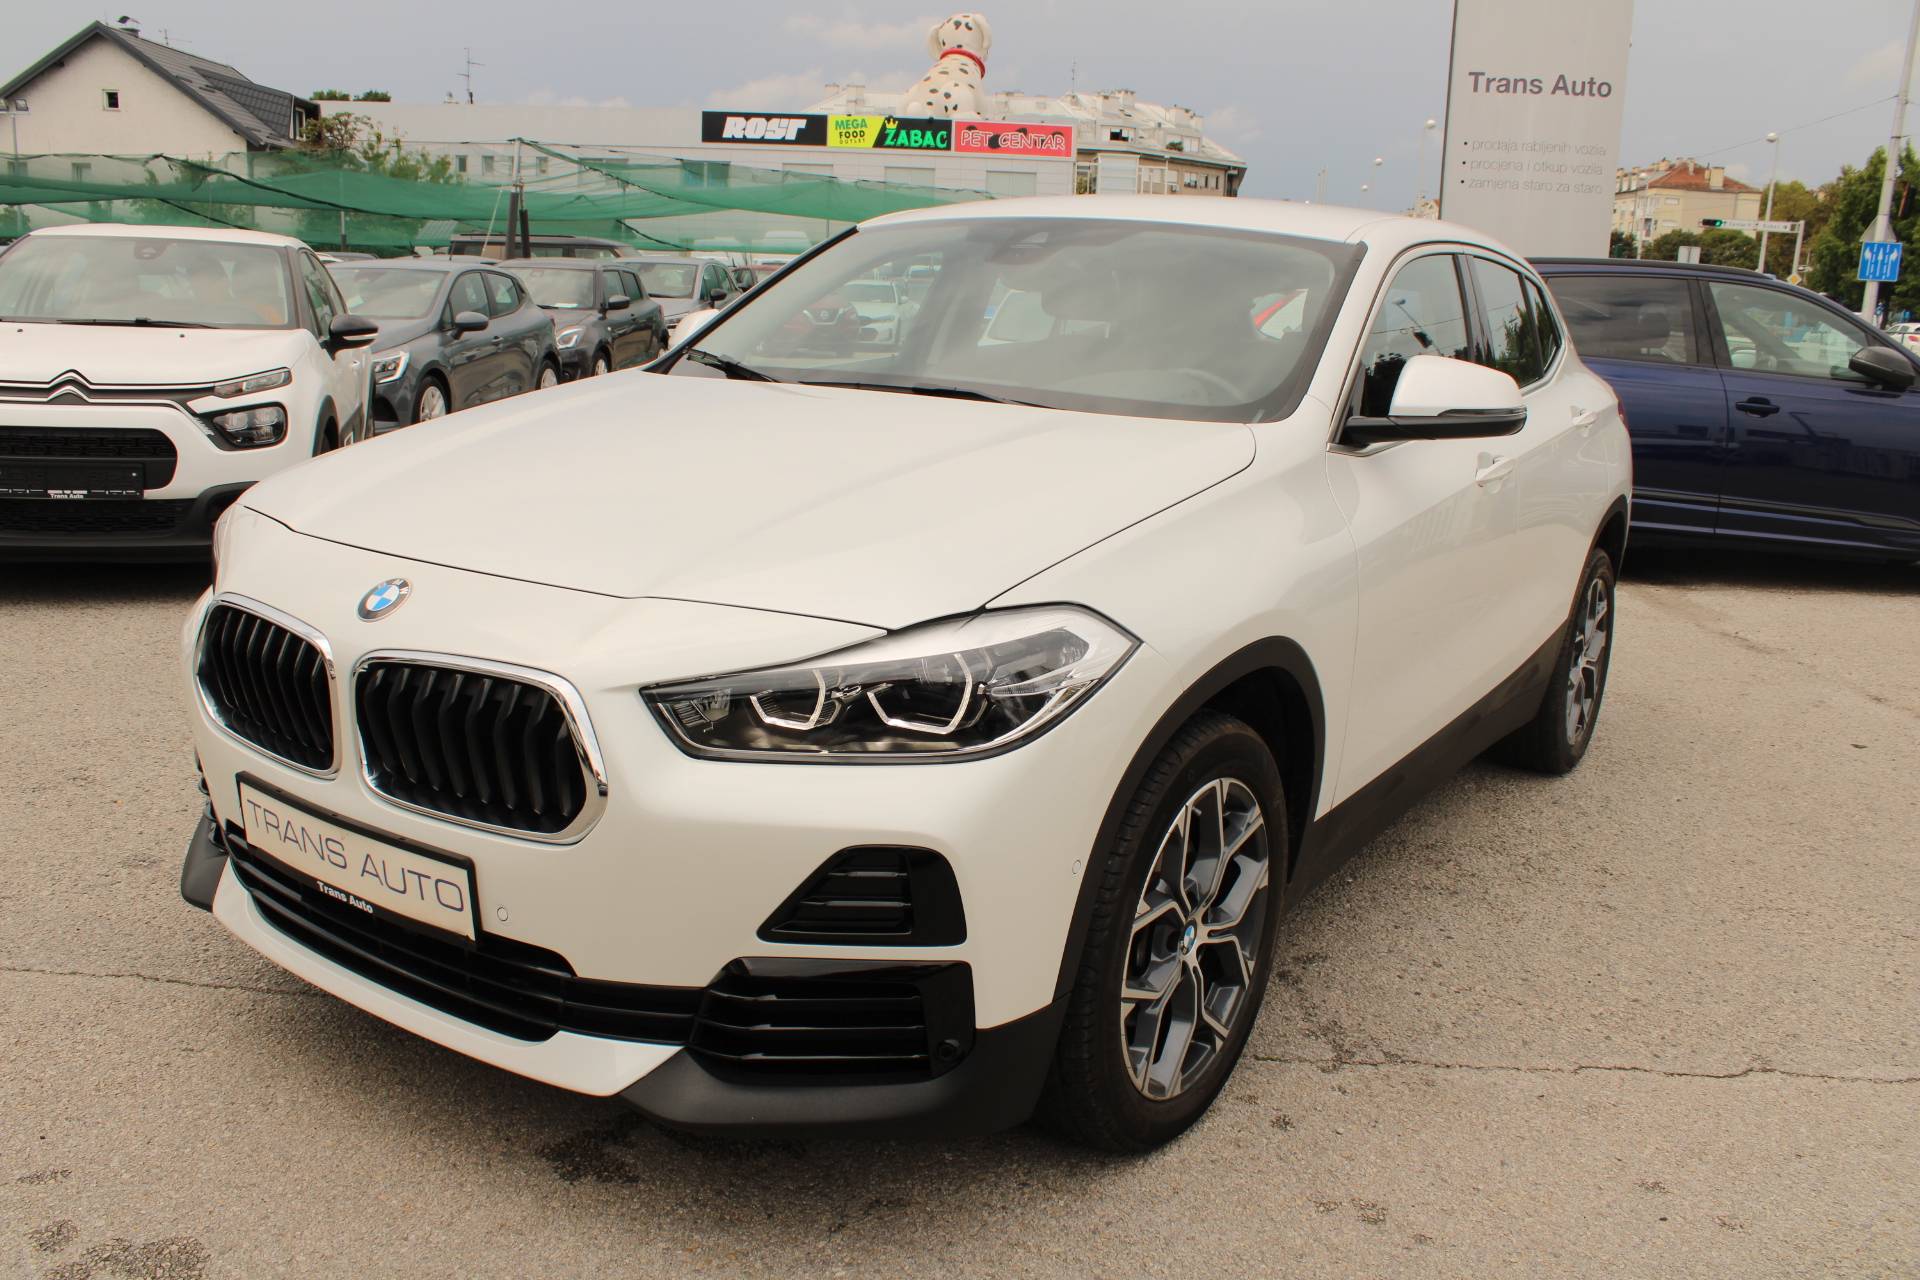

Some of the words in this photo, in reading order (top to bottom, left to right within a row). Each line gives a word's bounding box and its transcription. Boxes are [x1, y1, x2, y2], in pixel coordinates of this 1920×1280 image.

[1468, 71, 1543, 95] Trans
[1551, 74, 1612, 98] Auto
[722, 116, 807, 140] ROST
[835, 119, 868, 130] MEGA
[839, 130, 866, 139] FOOD
[960, 130, 993, 147] PET
[998, 132, 1066, 151] CENTAR
[1471, 139, 1518, 153] prodaja
[1533, 160, 1567, 174] otkup
[1556, 182, 1570, 192] za
[246, 798, 348, 870] TRANS
[360, 853, 464, 912] AUTO
[316, 880, 347, 902] Trans
[349, 895, 374, 914] Auto
